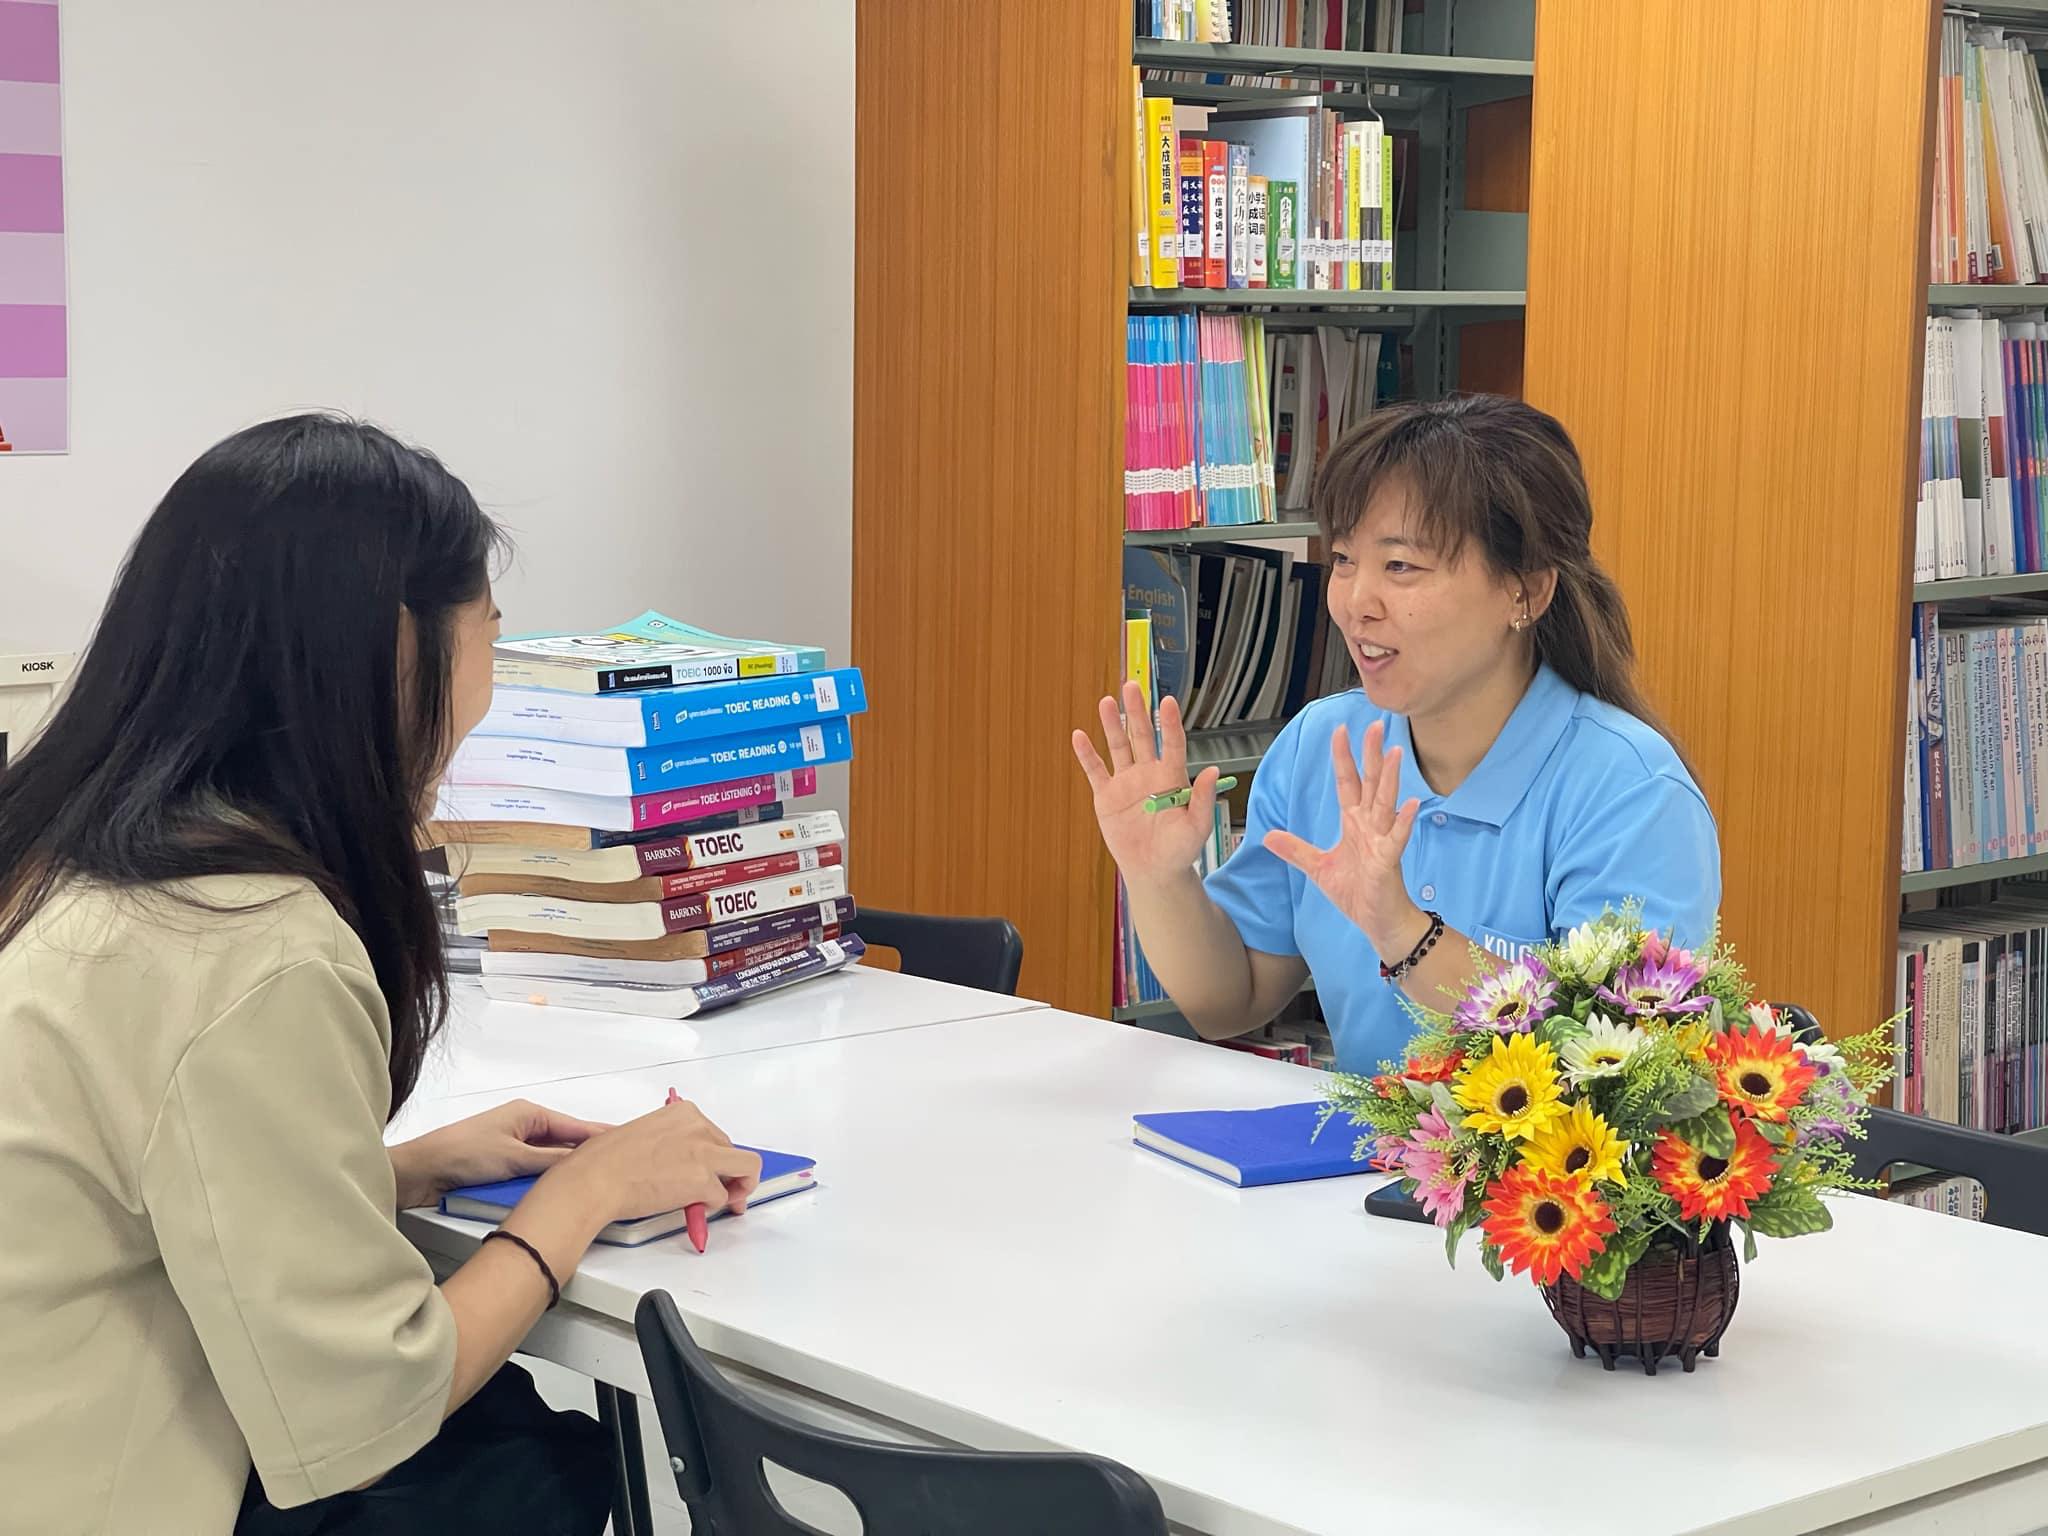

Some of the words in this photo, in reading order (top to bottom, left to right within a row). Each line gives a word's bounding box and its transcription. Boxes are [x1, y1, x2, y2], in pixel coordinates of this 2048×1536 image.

[1982, 436, 1990, 476] Chinese
[1984, 478, 1992, 510] Nation
[1127, 583, 1176, 608] English
[22, 661, 54, 672] KIOSK
[676, 666, 702, 680] TOEIC
[703, 664, 723, 676] 1000
[724, 701, 751, 715] TOEIC
[752, 695, 791, 712] READING
[710, 751, 736, 764] TOEIC
[738, 745, 776, 759] READING
[700, 794, 721, 806] TOEIC
[721, 786, 753, 801] LISTENING
[644, 846, 681, 861] BARRON'S
[695, 833, 744, 857] TOEIC
[669, 904, 703, 920] BARRON'S
[715, 889, 757, 916] TOEIC
[1484, 933, 1532, 965] KOIC
